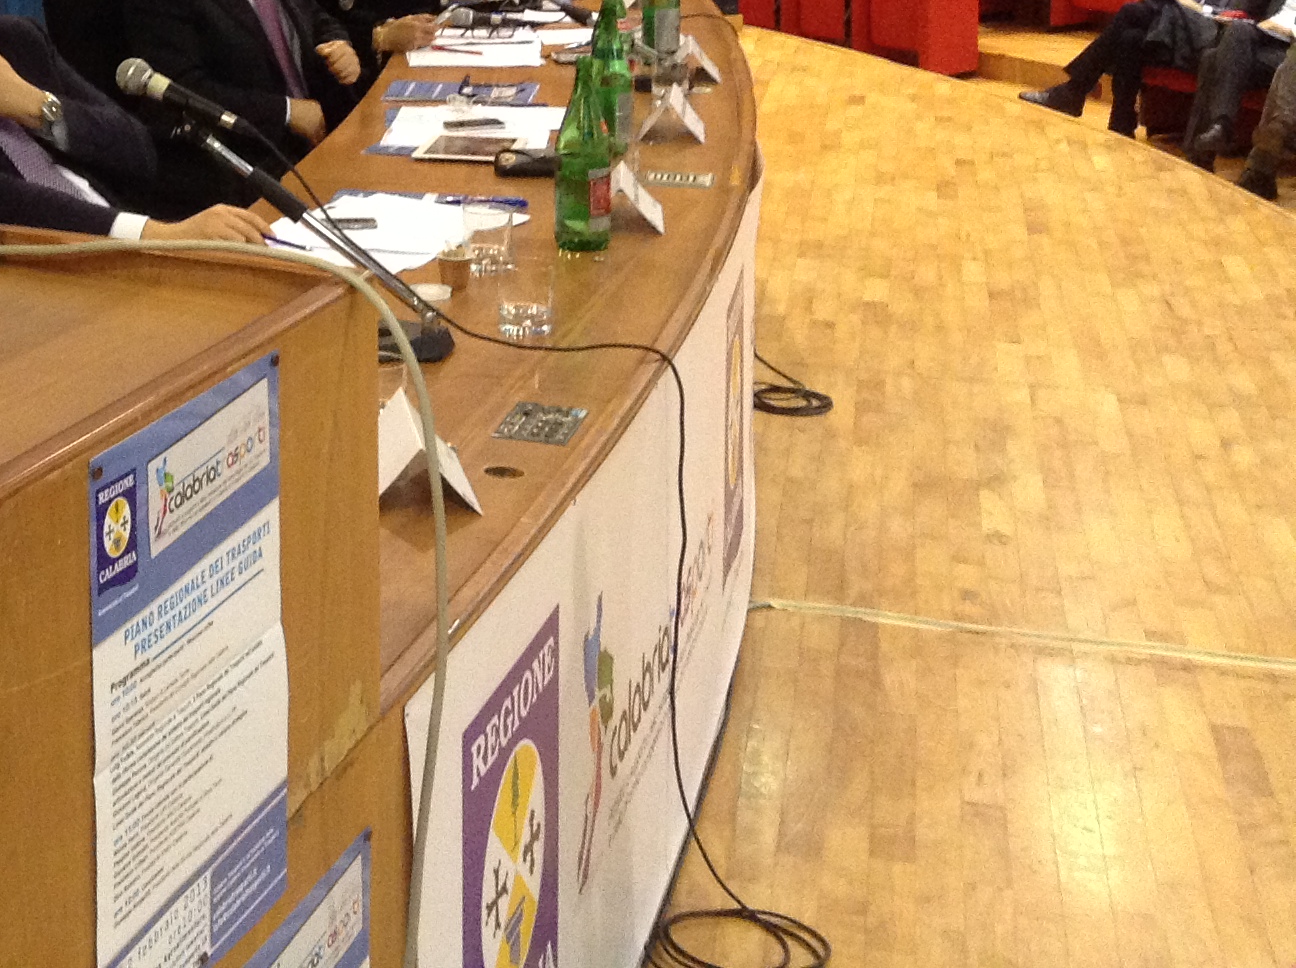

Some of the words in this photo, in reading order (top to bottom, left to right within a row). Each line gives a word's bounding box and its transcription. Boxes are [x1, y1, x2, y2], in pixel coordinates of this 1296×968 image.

[98, 473, 135, 506] REGIONE
[99, 550, 137, 584] CALABRIA
[124, 610, 154, 645] PIANO
[157, 573, 206, 620] REGIONALE
[209, 558, 224, 578] DEI
[226, 521, 270, 565] TRASPORTI
[134, 593, 208, 660] PRESENTAZIONE
[210, 570, 236, 598] LINEE
[238, 548, 263, 576] GUIDA
[110, 658, 150, 694] Programma
[470, 636, 555, 792] REGIONE
